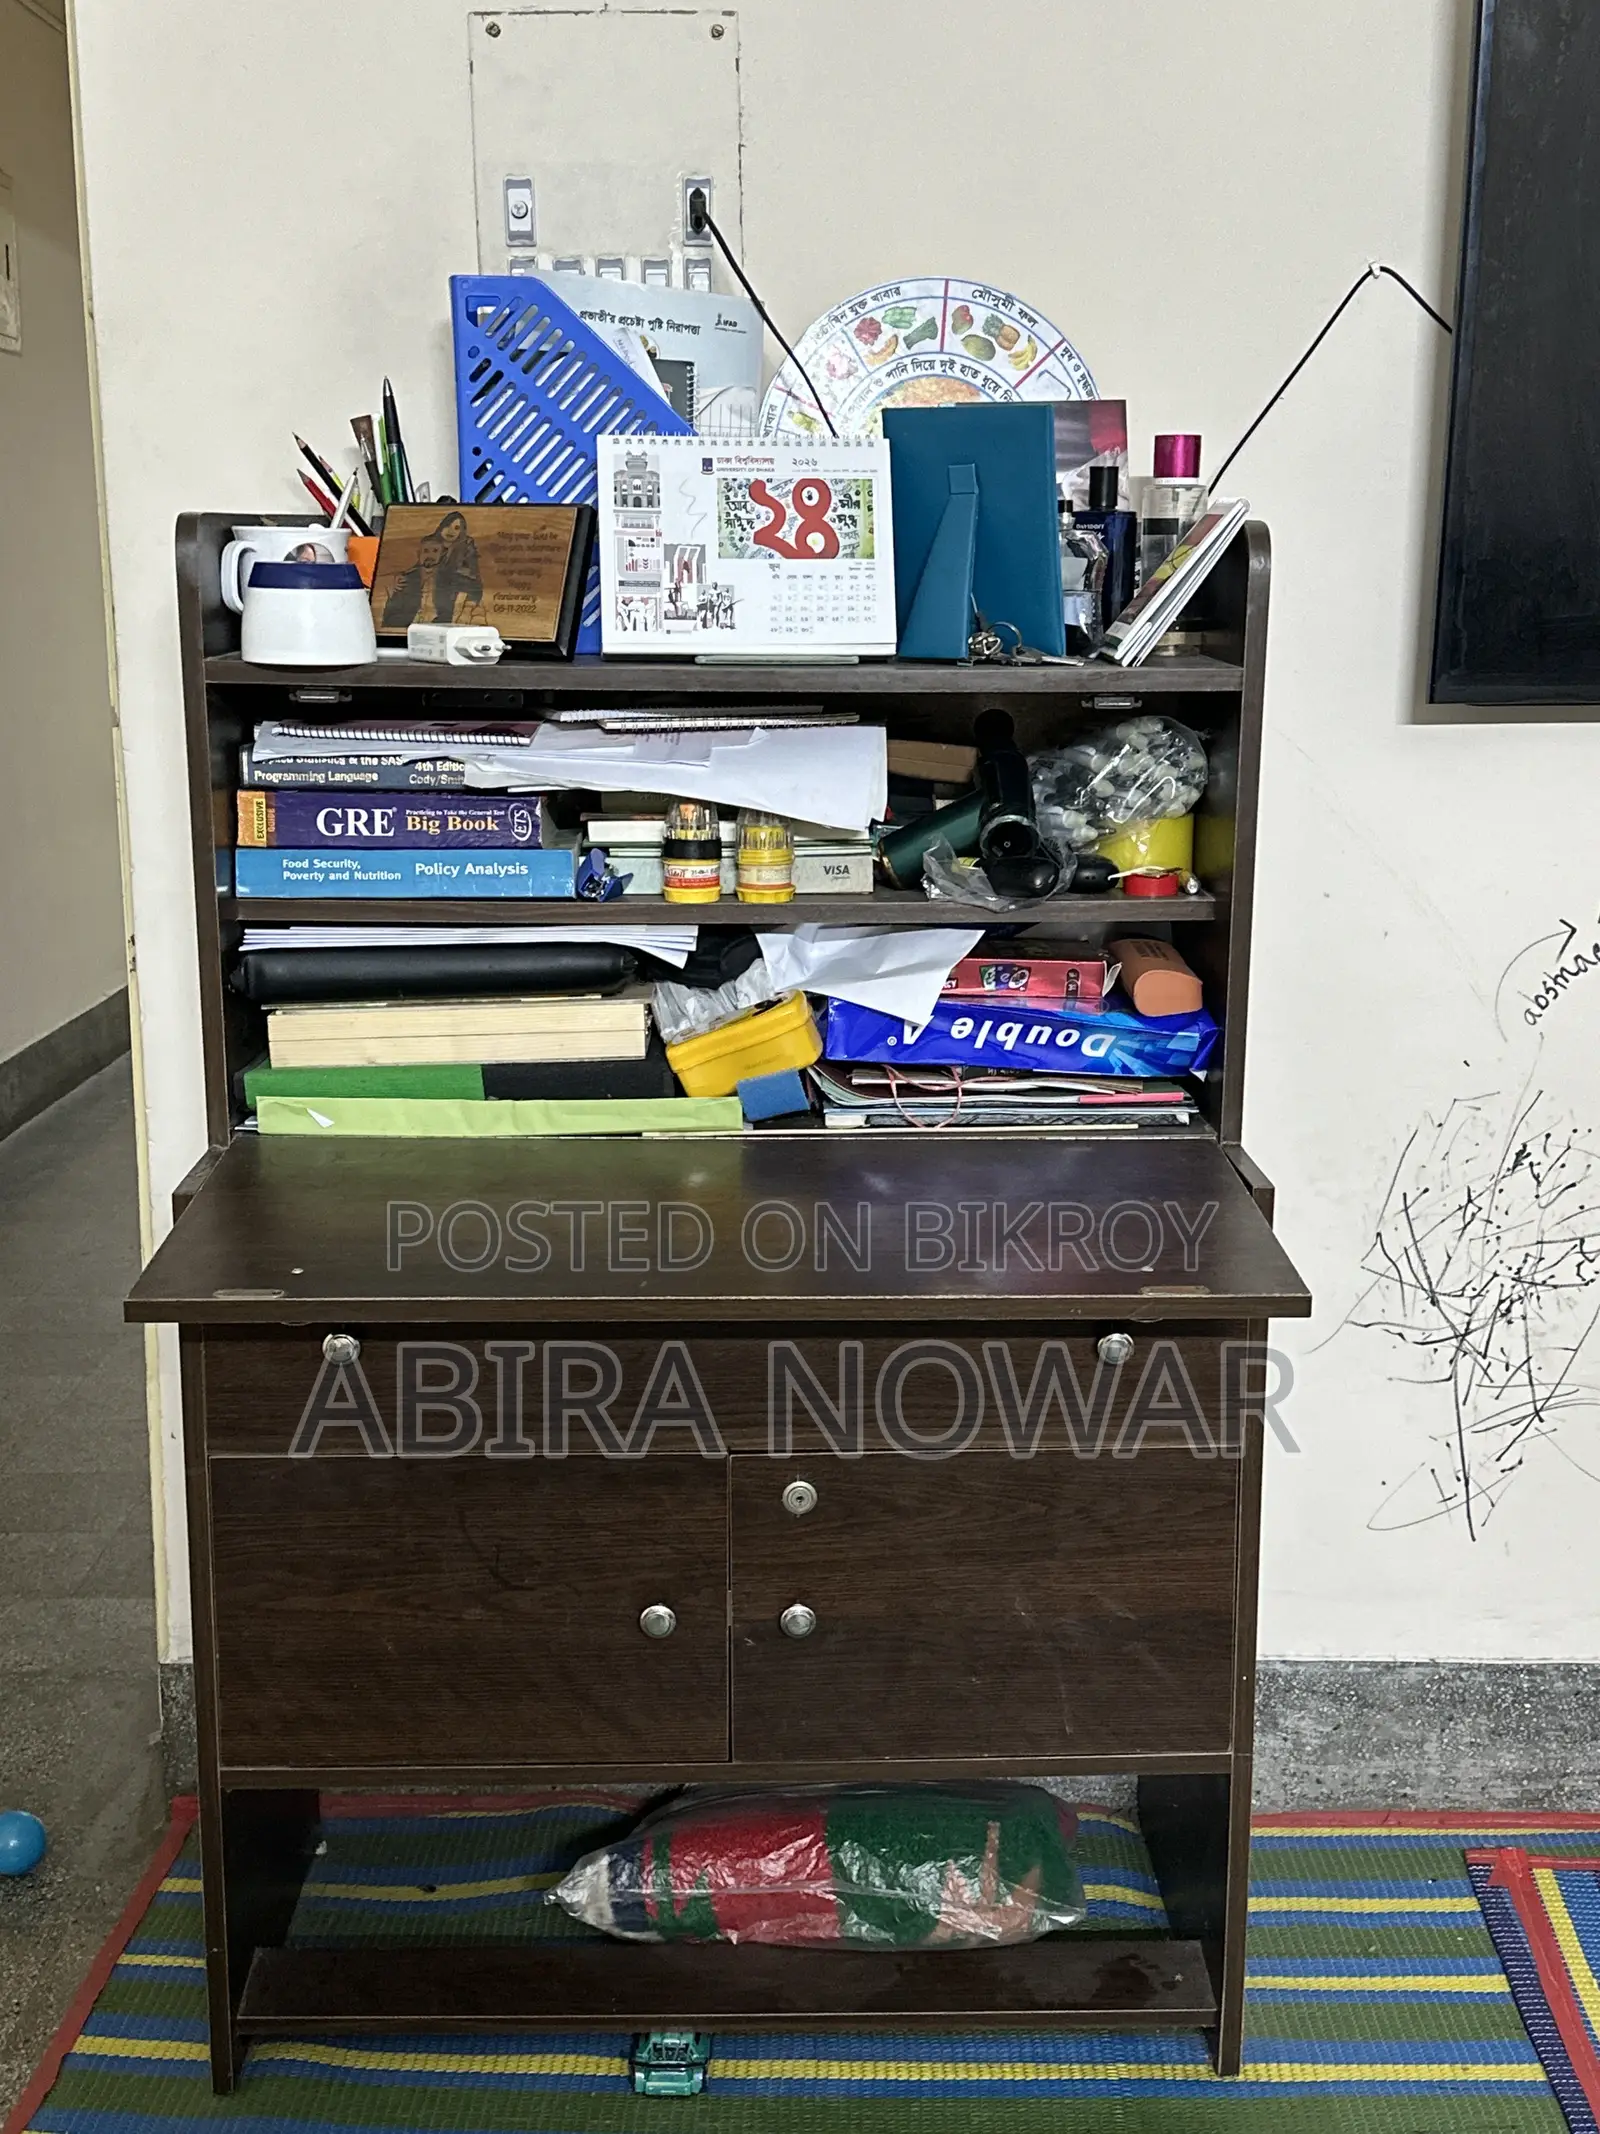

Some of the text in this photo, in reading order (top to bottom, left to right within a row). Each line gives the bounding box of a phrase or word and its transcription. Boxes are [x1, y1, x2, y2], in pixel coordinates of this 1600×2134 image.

[792, 457, 818, 467] ২০২৬
[415, 761, 434, 772] 4th
[253, 770, 379, 783] Programming Language
[405, 809, 436, 817] Practicing
[255, 801, 265, 840] EXCLUSIVE
[315, 807, 396, 837] GRE
[406, 815, 500, 836] Big Book
[513, 807, 527, 835] ETS
[282, 858, 361, 872] Food Security,
[415, 862, 529, 878] Policy Analysis
[823, 864, 851, 876] VISA
[283, 870, 402, 882] Poverty and Nutrition
[902, 1014, 1117, 1058] Double A
